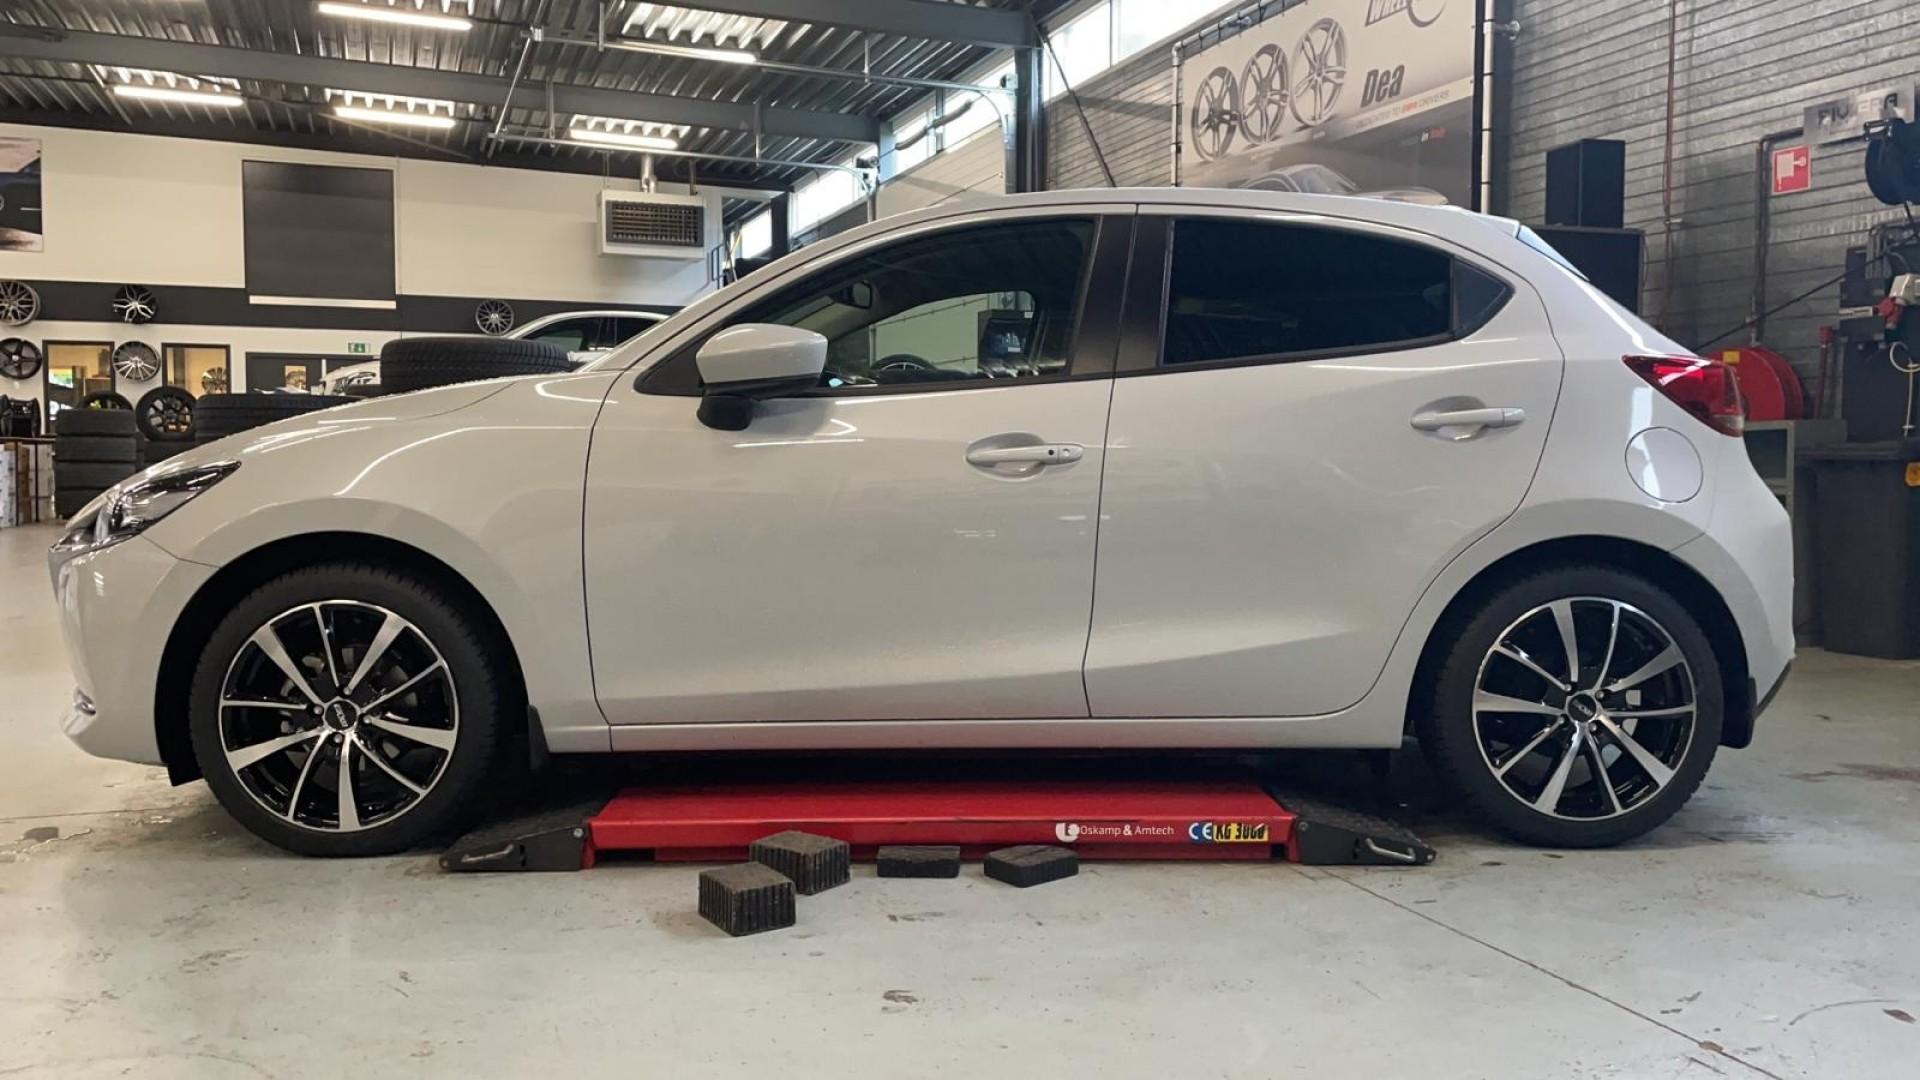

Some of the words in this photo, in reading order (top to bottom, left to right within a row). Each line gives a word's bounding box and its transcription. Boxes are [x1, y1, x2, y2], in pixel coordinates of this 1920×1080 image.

[1361, 65, 1404, 107] Dea
[1080, 825, 1121, 837] Oskamp
[1123, 824, 1132, 836] &
[1135, 825, 1174, 835] Amtech
